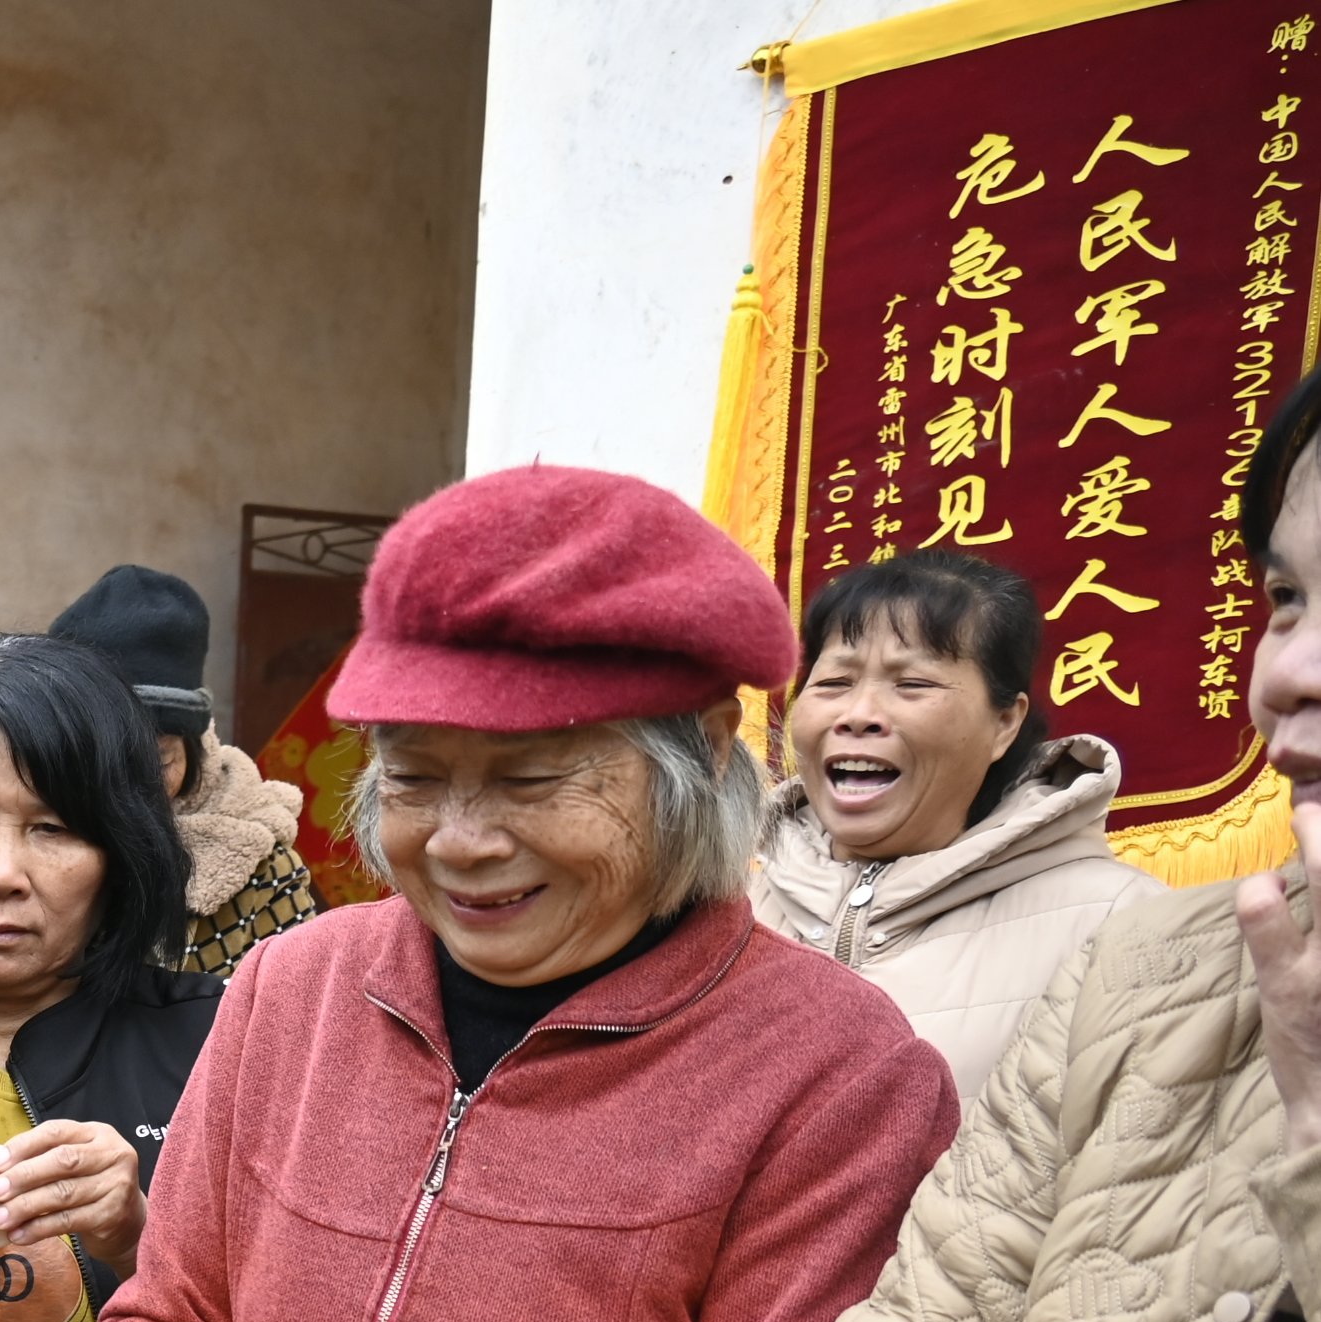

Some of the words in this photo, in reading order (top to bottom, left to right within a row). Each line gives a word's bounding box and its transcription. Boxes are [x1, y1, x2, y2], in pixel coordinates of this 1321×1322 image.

[918, 134, 1045, 549] 危急时刻见
[1044, 115, 1190, 707] 人民军人爱人民
